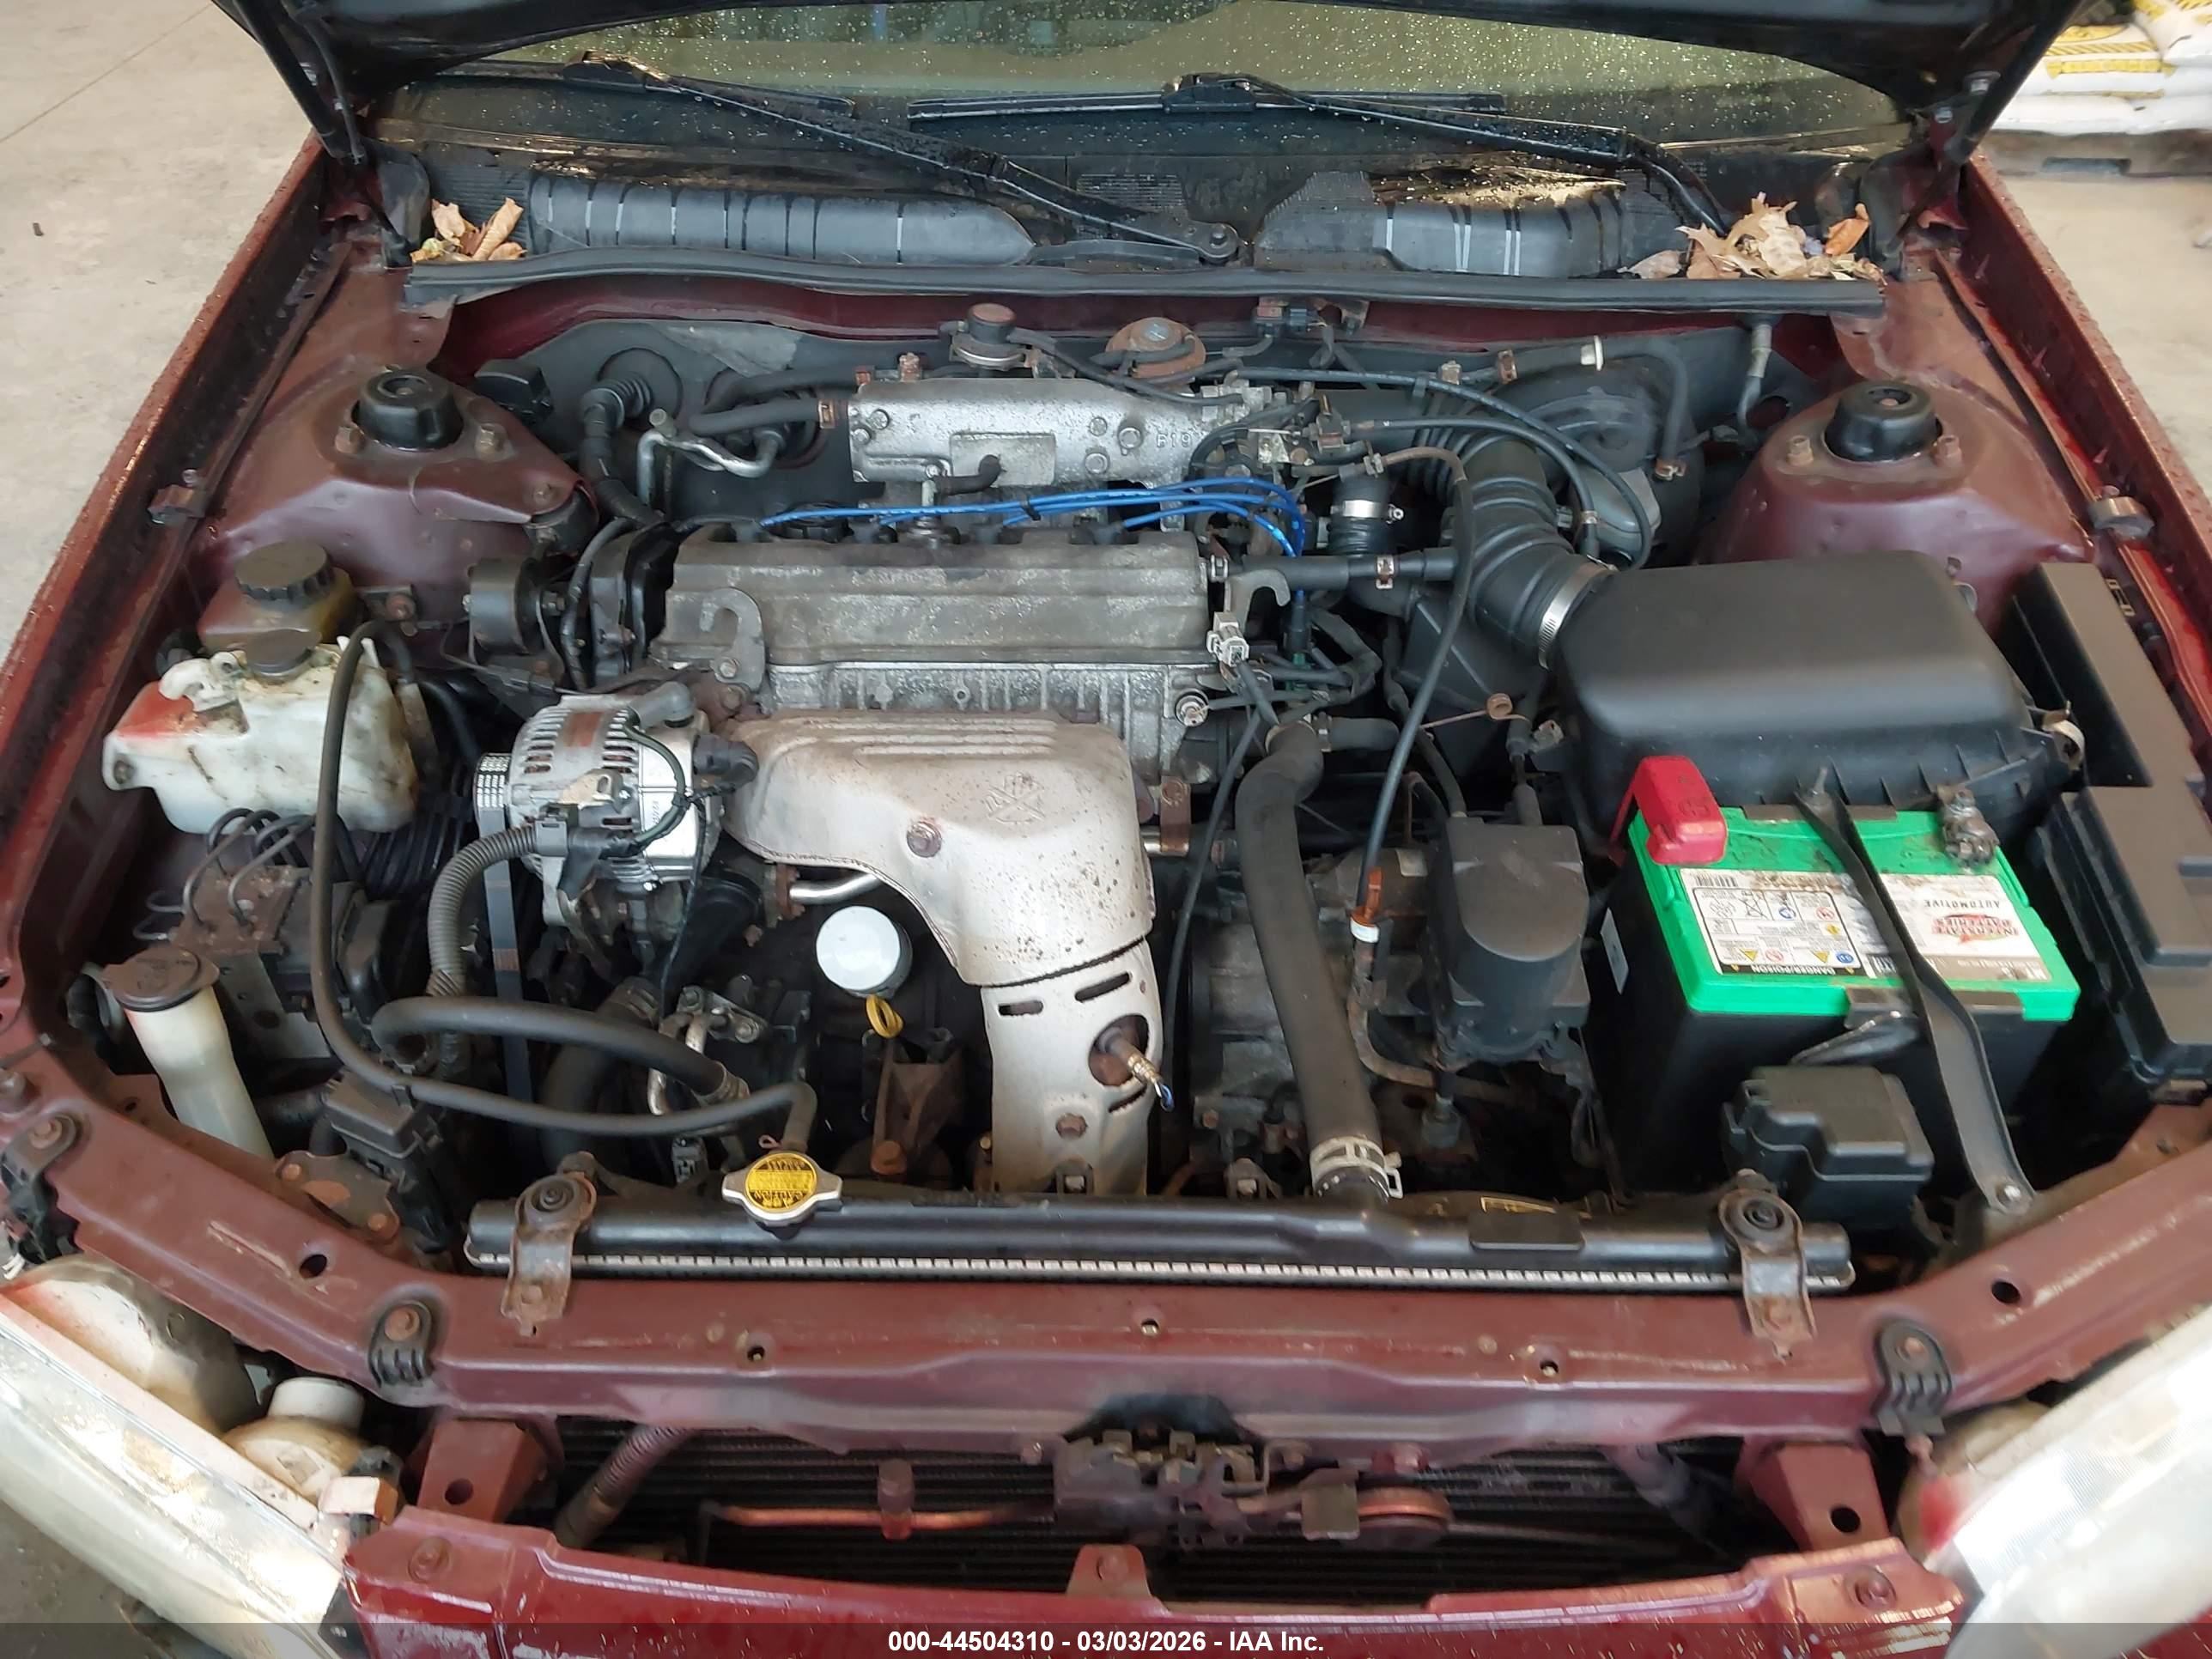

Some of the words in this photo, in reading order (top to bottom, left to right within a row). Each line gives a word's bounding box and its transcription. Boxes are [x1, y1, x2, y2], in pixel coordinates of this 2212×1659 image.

[1923, 899, 2000, 908] AUTOMOTIVE
[1935, 926, 2019, 937] INTERSTATE
[1750, 964, 1836, 976] DANGER/POISON
